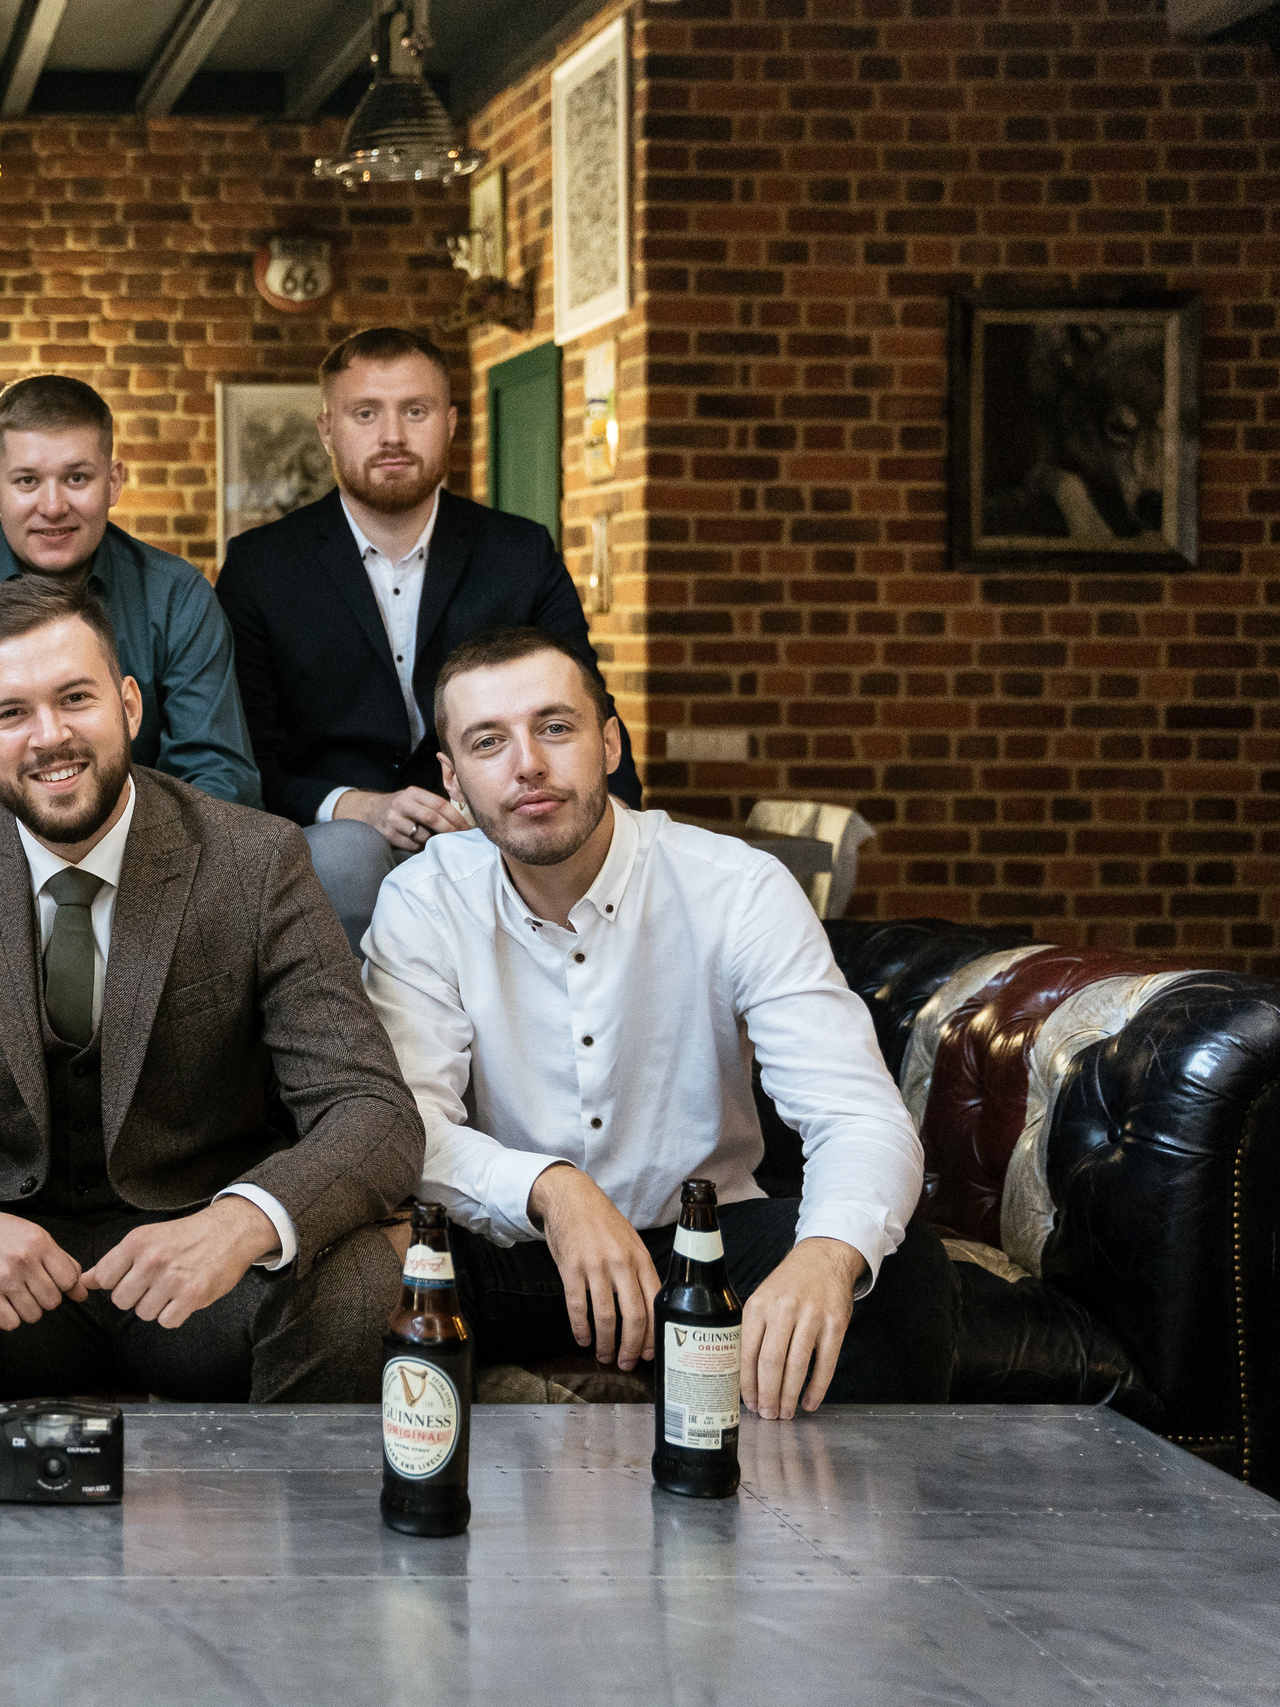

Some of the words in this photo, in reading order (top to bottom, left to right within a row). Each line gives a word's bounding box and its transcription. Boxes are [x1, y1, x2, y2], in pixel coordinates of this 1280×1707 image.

[282, 260, 319, 296] 66
[692, 1330, 740, 1343] GUINNESS
[698, 1343, 737, 1352] ORIGINAL
[383, 1401, 452, 1428] GUINNESS
[386, 1422, 442, 1441] ORIGINAL
[386, 1443, 399, 1462] DARK
[400, 1462, 415, 1470] AND
[417, 1451, 442, 1471] LIVELY
